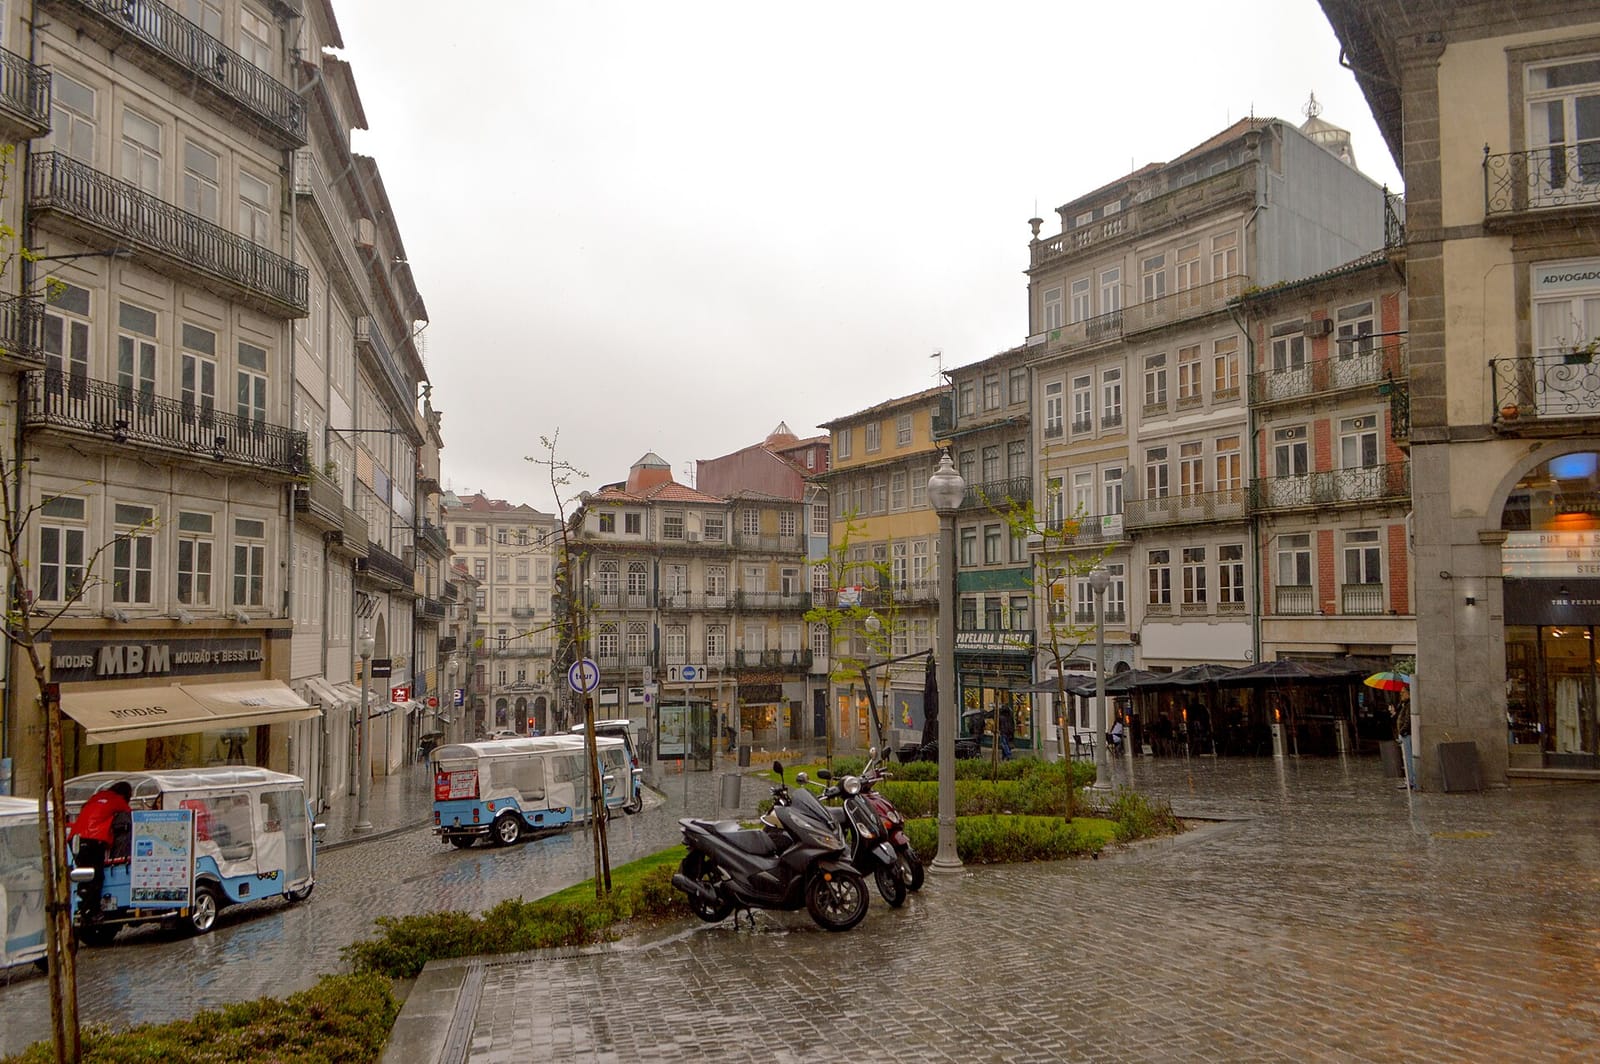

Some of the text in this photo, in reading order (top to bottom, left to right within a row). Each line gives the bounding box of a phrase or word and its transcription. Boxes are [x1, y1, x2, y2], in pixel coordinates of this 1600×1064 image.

[1540, 535, 1560, 544] PUT
[1567, 550, 1580, 558] ON
[957, 633, 994, 643] PAPELARIA
[56, 655, 93, 668] MODAS
[97, 644, 171, 675] MBM
[175, 649, 210, 664] MOURÃO
[221, 649, 248, 662] BESSA
[109, 706, 168, 718] MODAS
